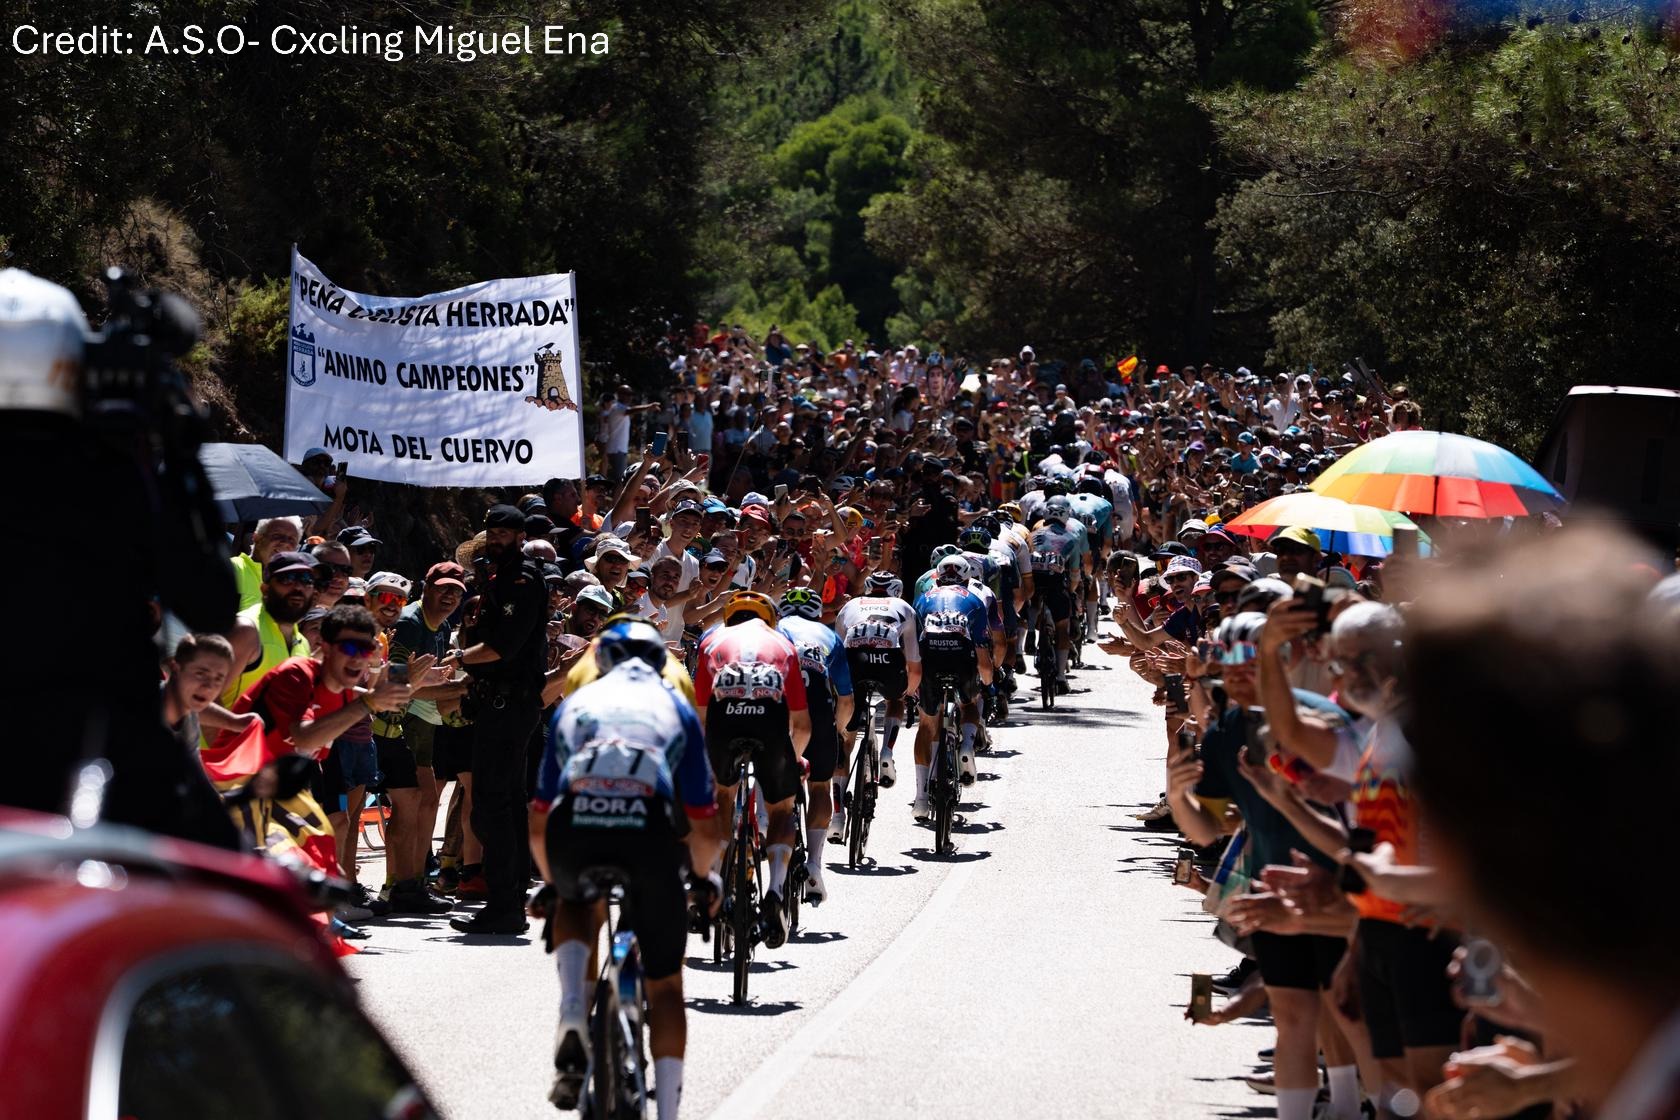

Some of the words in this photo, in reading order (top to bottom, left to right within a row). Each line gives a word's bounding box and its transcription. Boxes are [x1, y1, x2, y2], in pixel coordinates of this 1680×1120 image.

[324, 424, 384, 455] MOTA
[392, 434, 432, 460] DEL
[440, 437, 533, 464] CUERVO
[852, 623, 868, 639] 17
[874, 623, 890, 639] 17
[869, 652, 891, 664] IHC
[573, 796, 648, 815] BORA
